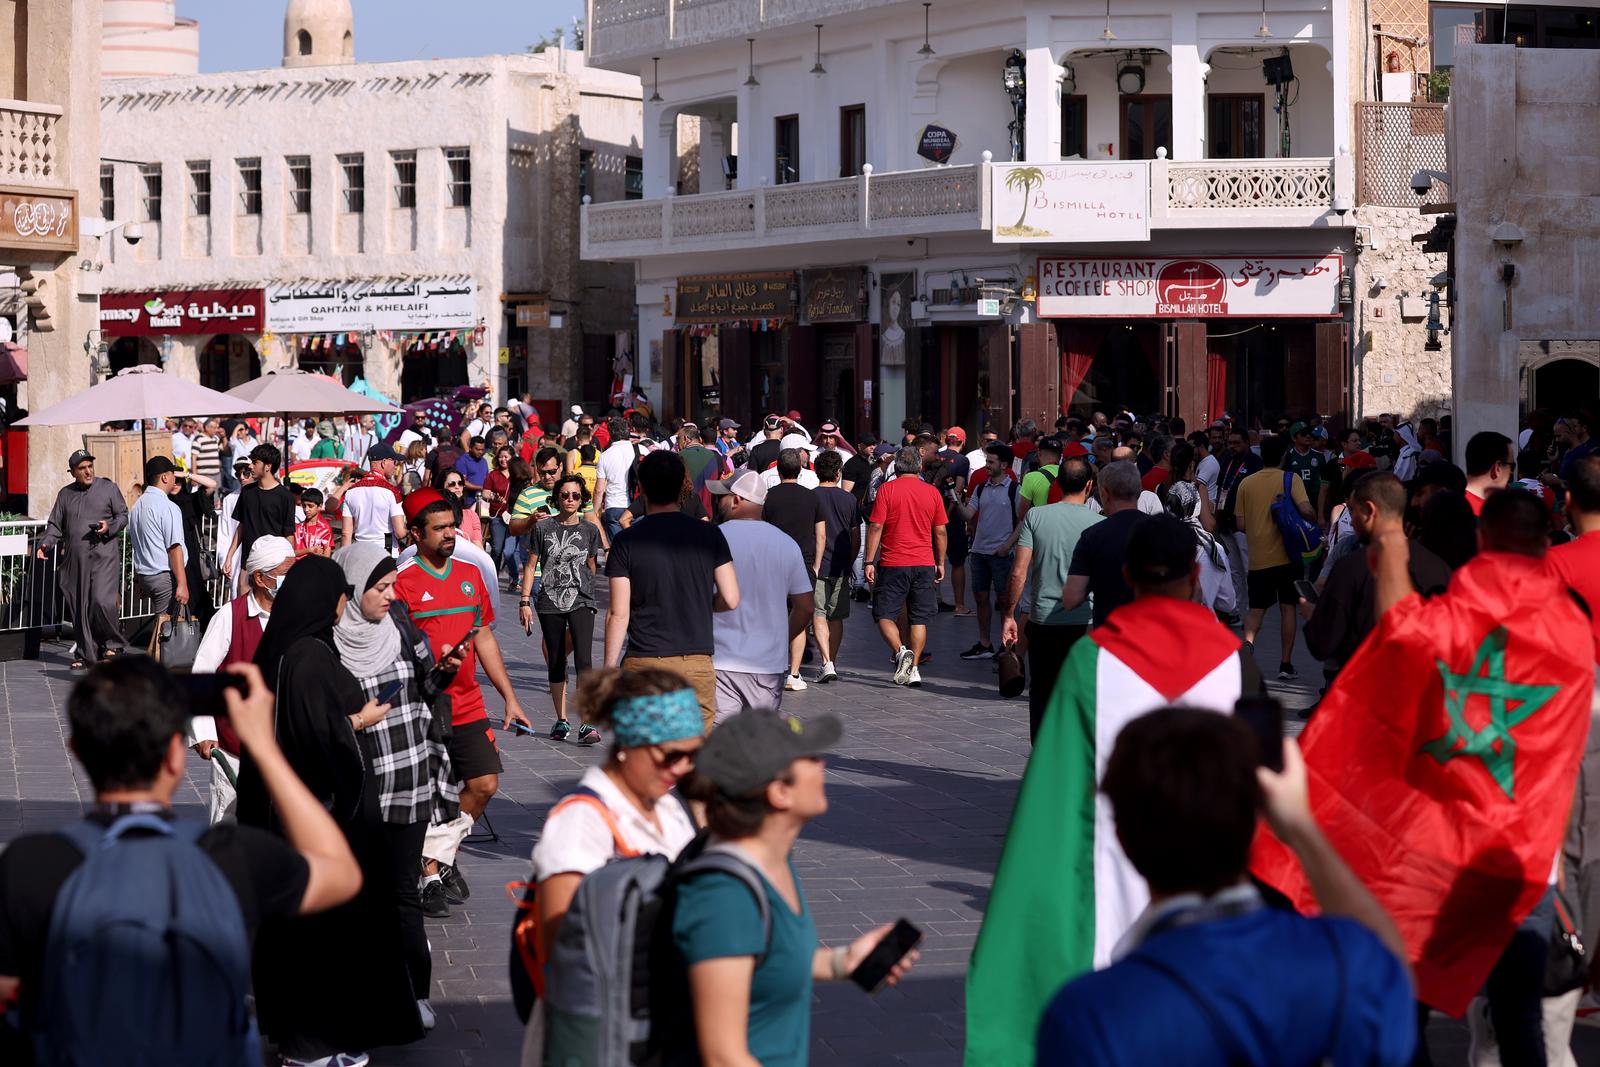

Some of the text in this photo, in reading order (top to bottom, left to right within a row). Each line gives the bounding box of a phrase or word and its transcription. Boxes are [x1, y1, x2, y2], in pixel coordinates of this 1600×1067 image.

[927, 130, 947, 138] COPA
[1043, 261, 1156, 279] RESTAURANT
[1055, 280, 1111, 296] COFFEE
[1117, 280, 1154, 297] SHOP
[311, 305, 360, 314] QAHTANI
[376, 303, 428, 312] KHELAIFI
[1158, 303, 1224, 314] BISMILLAH HOTEL
[1301, 469, 1311, 480] 12
